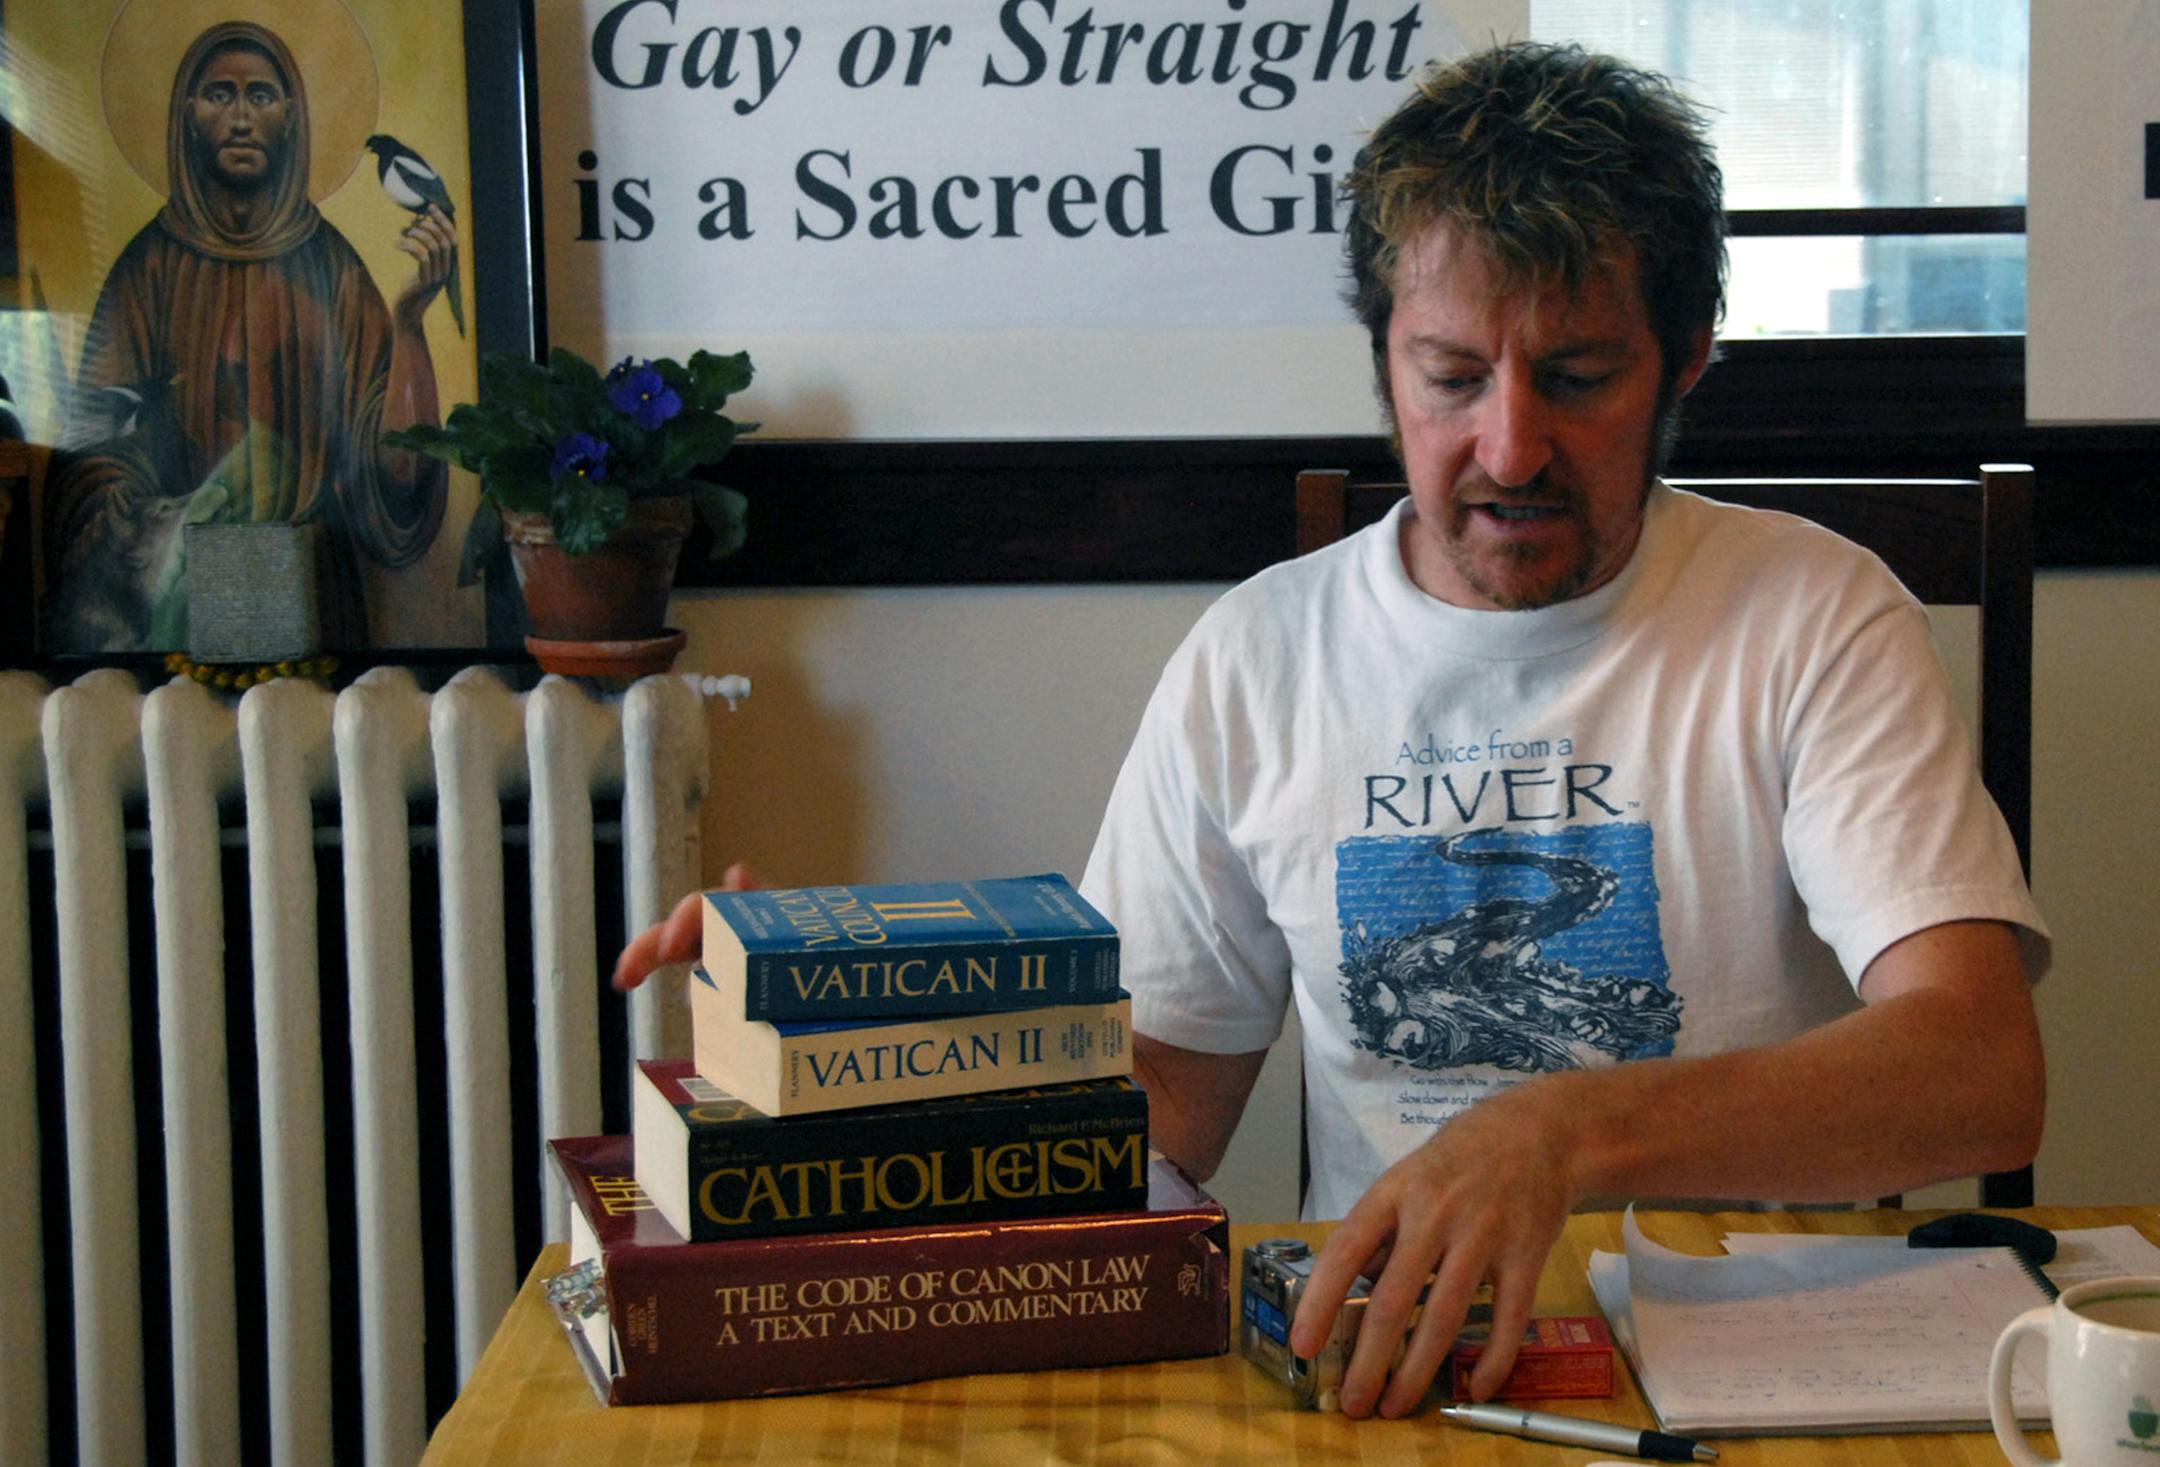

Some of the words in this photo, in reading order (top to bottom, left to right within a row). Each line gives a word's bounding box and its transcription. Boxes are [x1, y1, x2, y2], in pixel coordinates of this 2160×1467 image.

[591, 0, 800, 116] Gay
[838, 26, 952, 88] or
[982, 0, 1422, 111] Straight
[574, 150, 655, 242] is
[698, 178, 755, 241] a
[795, 149, 1169, 241] Sacred
[1209, 143, 1341, 237] Gi
[1396, 734, 1480, 765] Advice
[1487, 729, 1550, 760] from
[1557, 738, 1573, 756] a
[1364, 764, 1624, 829] RIVER
[789, 955, 998, 1001] VATICAN
[1020, 954, 1047, 991] II
[805, 1032, 1001, 1088] VATICAN
[1016, 1028, 1045, 1064] II
[699, 1133, 1146, 1225] CATHOLICISM
[715, 1284, 788, 1315] THE
[797, 1275, 891, 1308] CODE
[900, 1271, 943, 1300] OF
[949, 1261, 1074, 1297] CANON
[1081, 1254, 1151, 1286] LAW
[716, 1322, 740, 1346] A
[750, 1313, 837, 1343] TEXT
[843, 1306, 917, 1336] AND
[928, 1287, 1150, 1327] COMMENTARY
